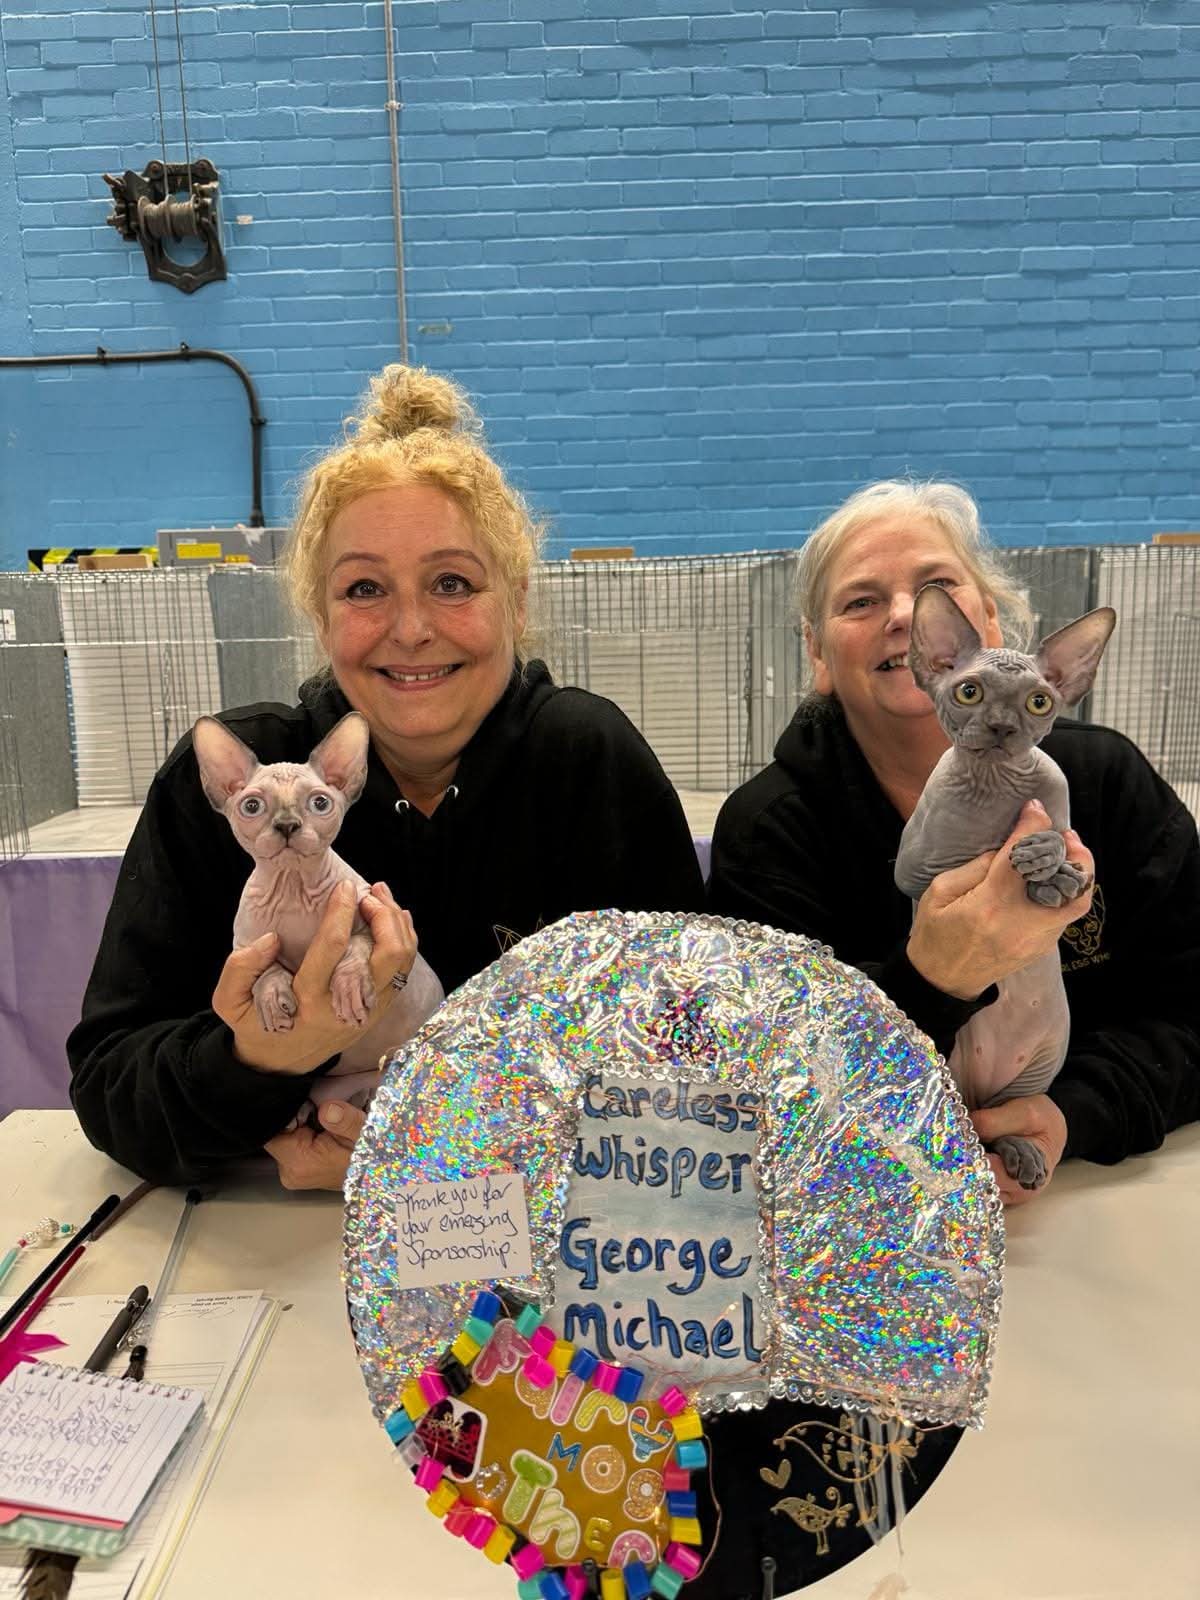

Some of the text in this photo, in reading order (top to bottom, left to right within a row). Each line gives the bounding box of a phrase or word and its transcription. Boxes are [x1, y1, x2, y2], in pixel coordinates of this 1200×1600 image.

[583, 1074, 761, 1133] Careless
[574, 1134, 752, 1198] Whisper
[396, 1176, 512, 1219] Thank you for
[402, 1217, 434, 1242] your
[560, 1217, 752, 1295] George
[564, 1292, 766, 1363] Michael
